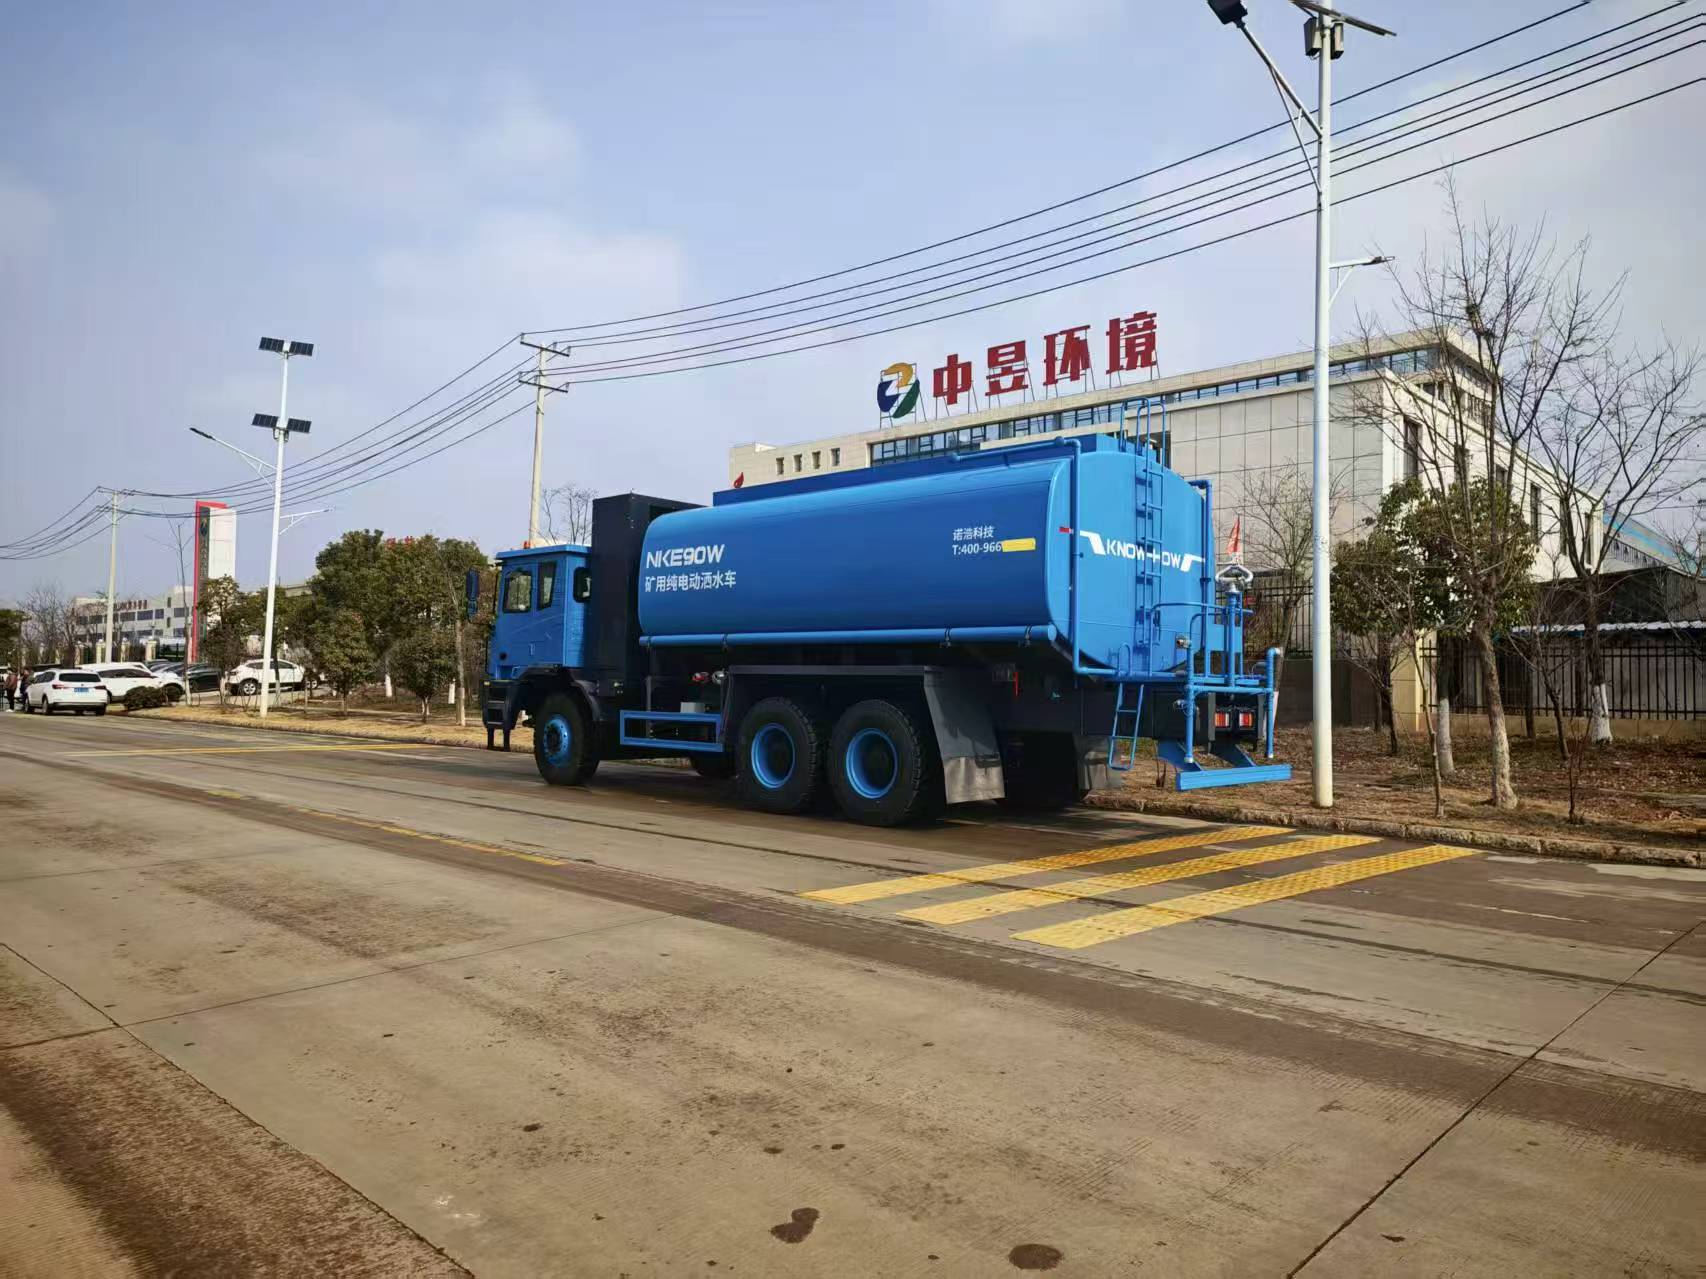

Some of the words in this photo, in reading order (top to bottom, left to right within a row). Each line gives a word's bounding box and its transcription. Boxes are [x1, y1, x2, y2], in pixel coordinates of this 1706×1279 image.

[933, 311, 1157, 405] 中昱环境
[953, 526, 994, 541] 诺浩科技
[646, 544, 725, 568] NKE90W
[645, 570, 736, 592] 矿用纯电动洒水车
